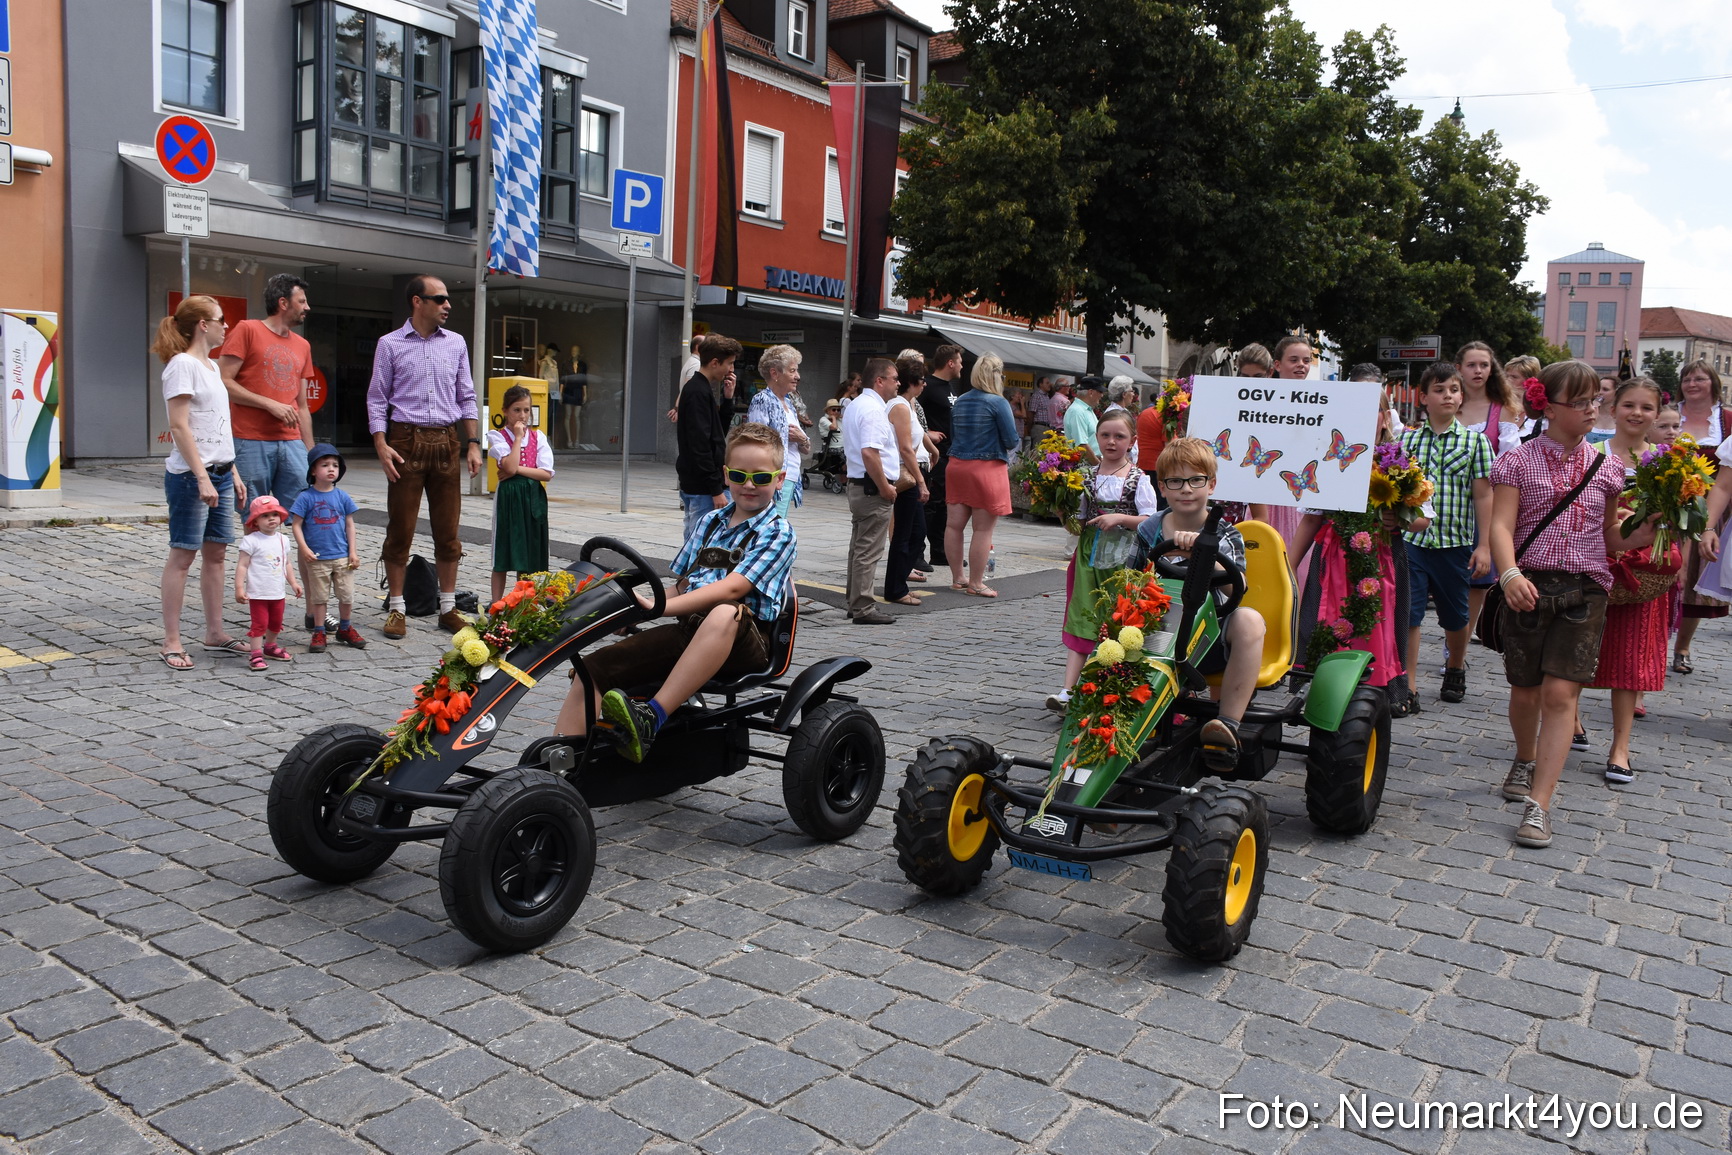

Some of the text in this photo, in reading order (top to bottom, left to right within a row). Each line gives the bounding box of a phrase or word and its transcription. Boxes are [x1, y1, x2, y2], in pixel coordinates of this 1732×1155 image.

[168, 190, 206, 203] Elektrofahrzeuge
[623, 178, 651, 223] P
[173, 202, 192, 210] während
[171, 212, 203, 222] Ladevorgangs
[182, 223, 193, 231] frei
[12, 348, 24, 386] jellyfish
[1237, 388, 1276, 402] OGV
[1290, 390, 1329, 405] Kids
[1238, 409, 1324, 427] Rittershof
[1031, 819, 1066, 833] BERG
[1009, 852, 1089, 879] NM-LH-7
